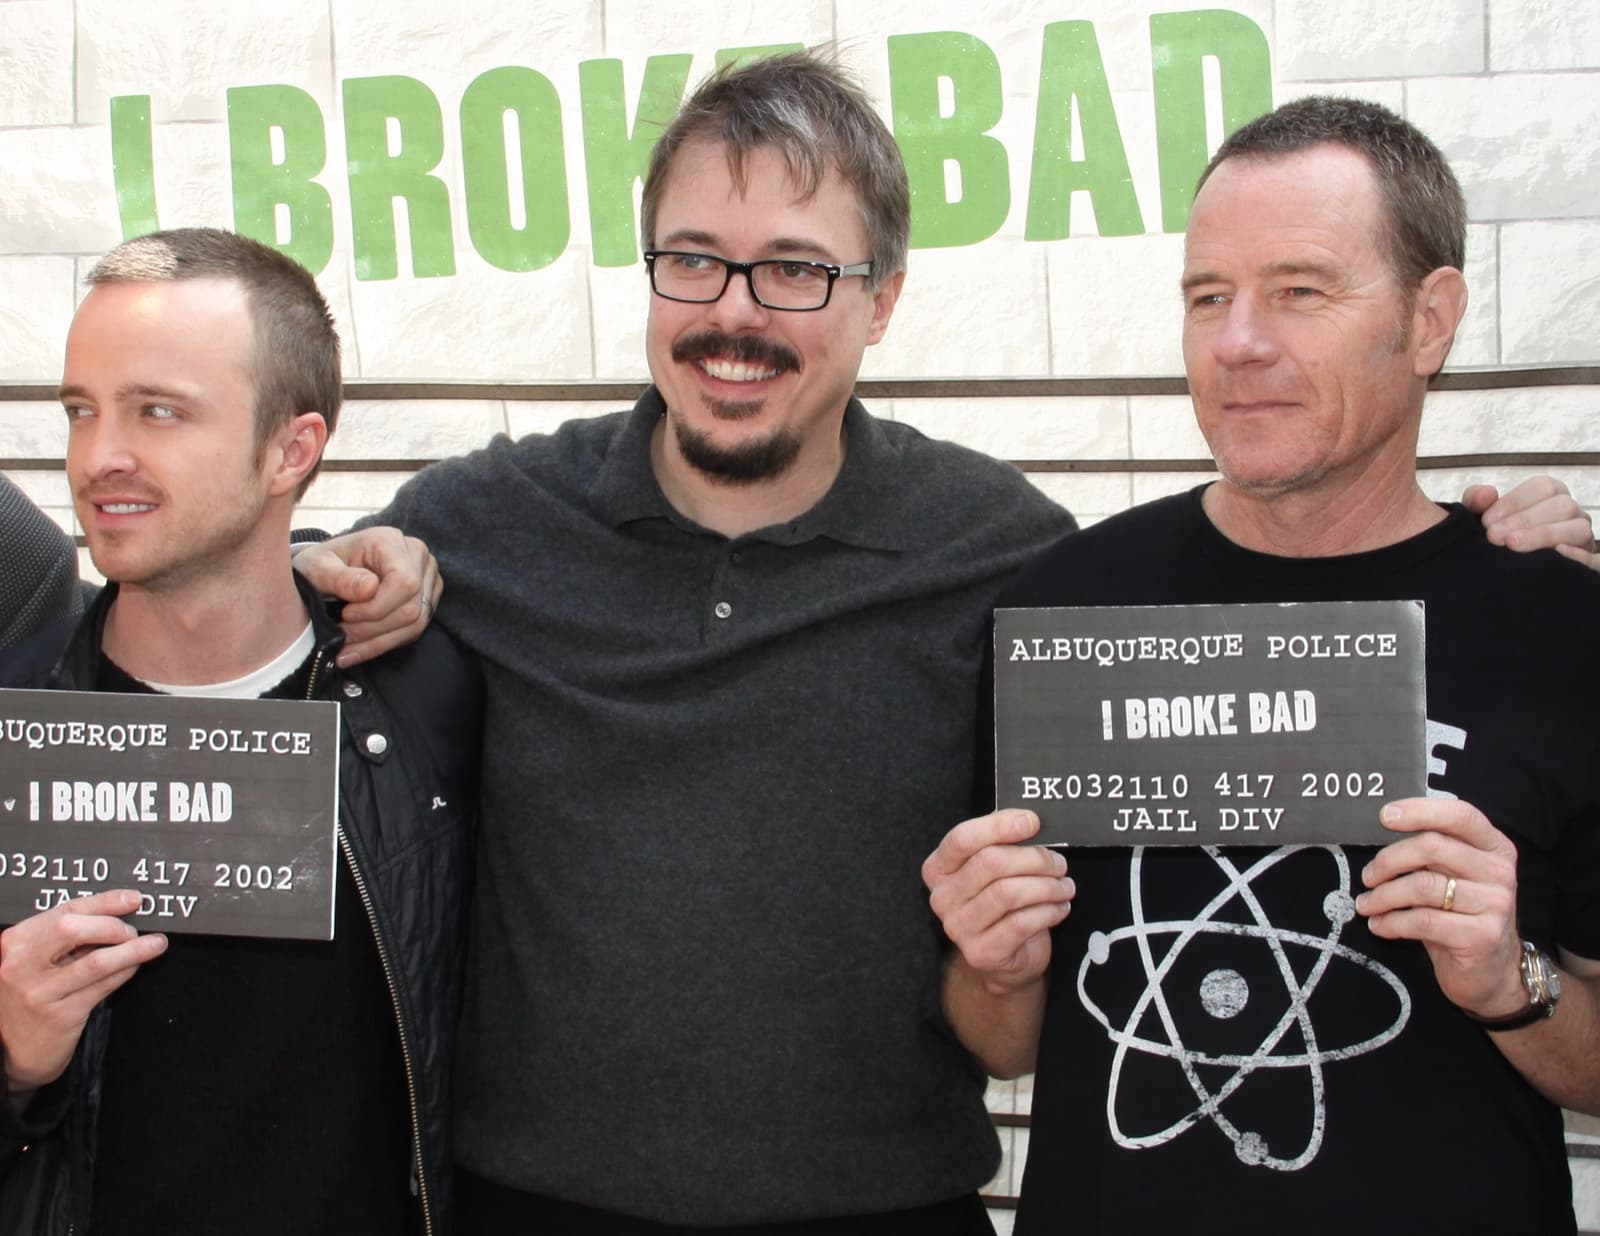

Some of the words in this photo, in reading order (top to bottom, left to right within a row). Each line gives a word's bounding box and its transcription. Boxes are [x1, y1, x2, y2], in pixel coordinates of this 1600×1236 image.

[109, 94, 159, 242] I
[226, 42, 805, 281] BROK
[886, 8, 1274, 250] BAD
[1009, 634, 1243, 667] ALBUQUERQUE
[1267, 633, 1397, 659] POLICE
[1102, 699, 1113, 741] I
[1125, 693, 1238, 740] BROKE
[1249, 690, 1317, 733] BAD
[0, 719, 167, 752] UQUERQUE
[189, 727, 311, 755] POLICE
[30, 781, 40, 822] I
[52, 781, 158, 822] BROKE
[169, 782, 233, 823] BAD
[1021, 773, 1188, 800] BK032110
[1214, 771, 1274, 799] 417
[1301, 772, 1384, 797] 2002
[1113, 807, 1197, 832] JAIL
[1218, 807, 1285, 831] DIV
[132, 857, 191, 887] 417
[214, 863, 293, 890] 2002
[135, 894, 198, 918] DIV
